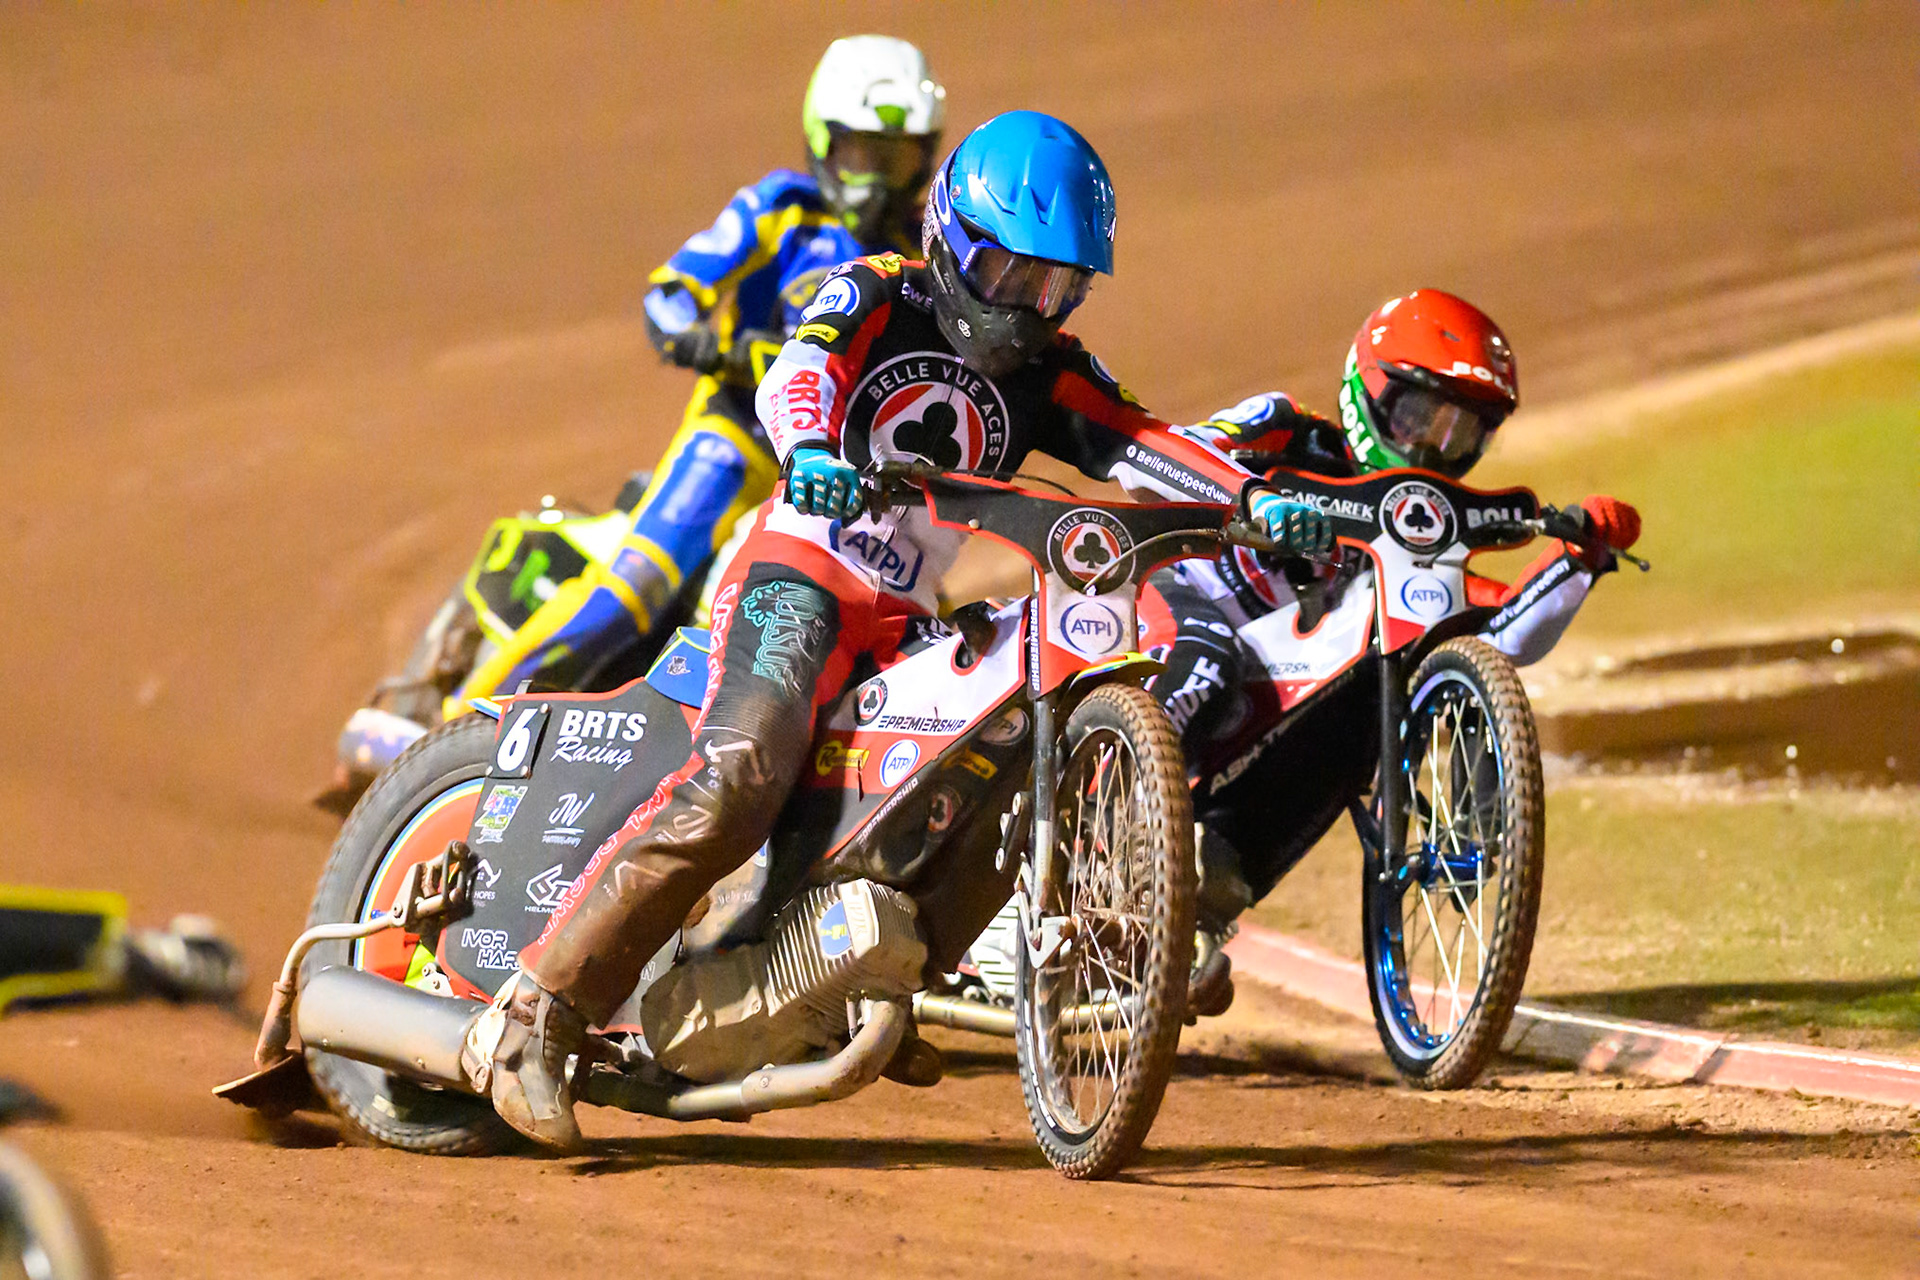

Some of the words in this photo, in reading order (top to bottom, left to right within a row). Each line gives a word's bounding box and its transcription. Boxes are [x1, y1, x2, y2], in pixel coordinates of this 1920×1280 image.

[867, 362, 930, 401] BELLE
[942, 364, 983, 397] VUE
[981, 403, 1002, 457] ACES
[1053, 515, 1081, 543] BELLE
[1084, 513, 1106, 524] VUE
[1109, 524, 1130, 549] ACES
[843, 530, 907, 582] ATPI
[1410, 589, 1444, 604] ATPI
[1071, 618, 1112, 637] ATPI
[496, 708, 539, 772] 6
[558, 708, 648, 742] BRTS
[550, 734, 634, 773] Racing
[886, 756, 912, 771] ATPI
[548, 792, 595, 828] JW
[524, 905, 556, 915] HELM
[461, 928, 509, 951] IVOR
[476, 948, 521, 971] HAR
